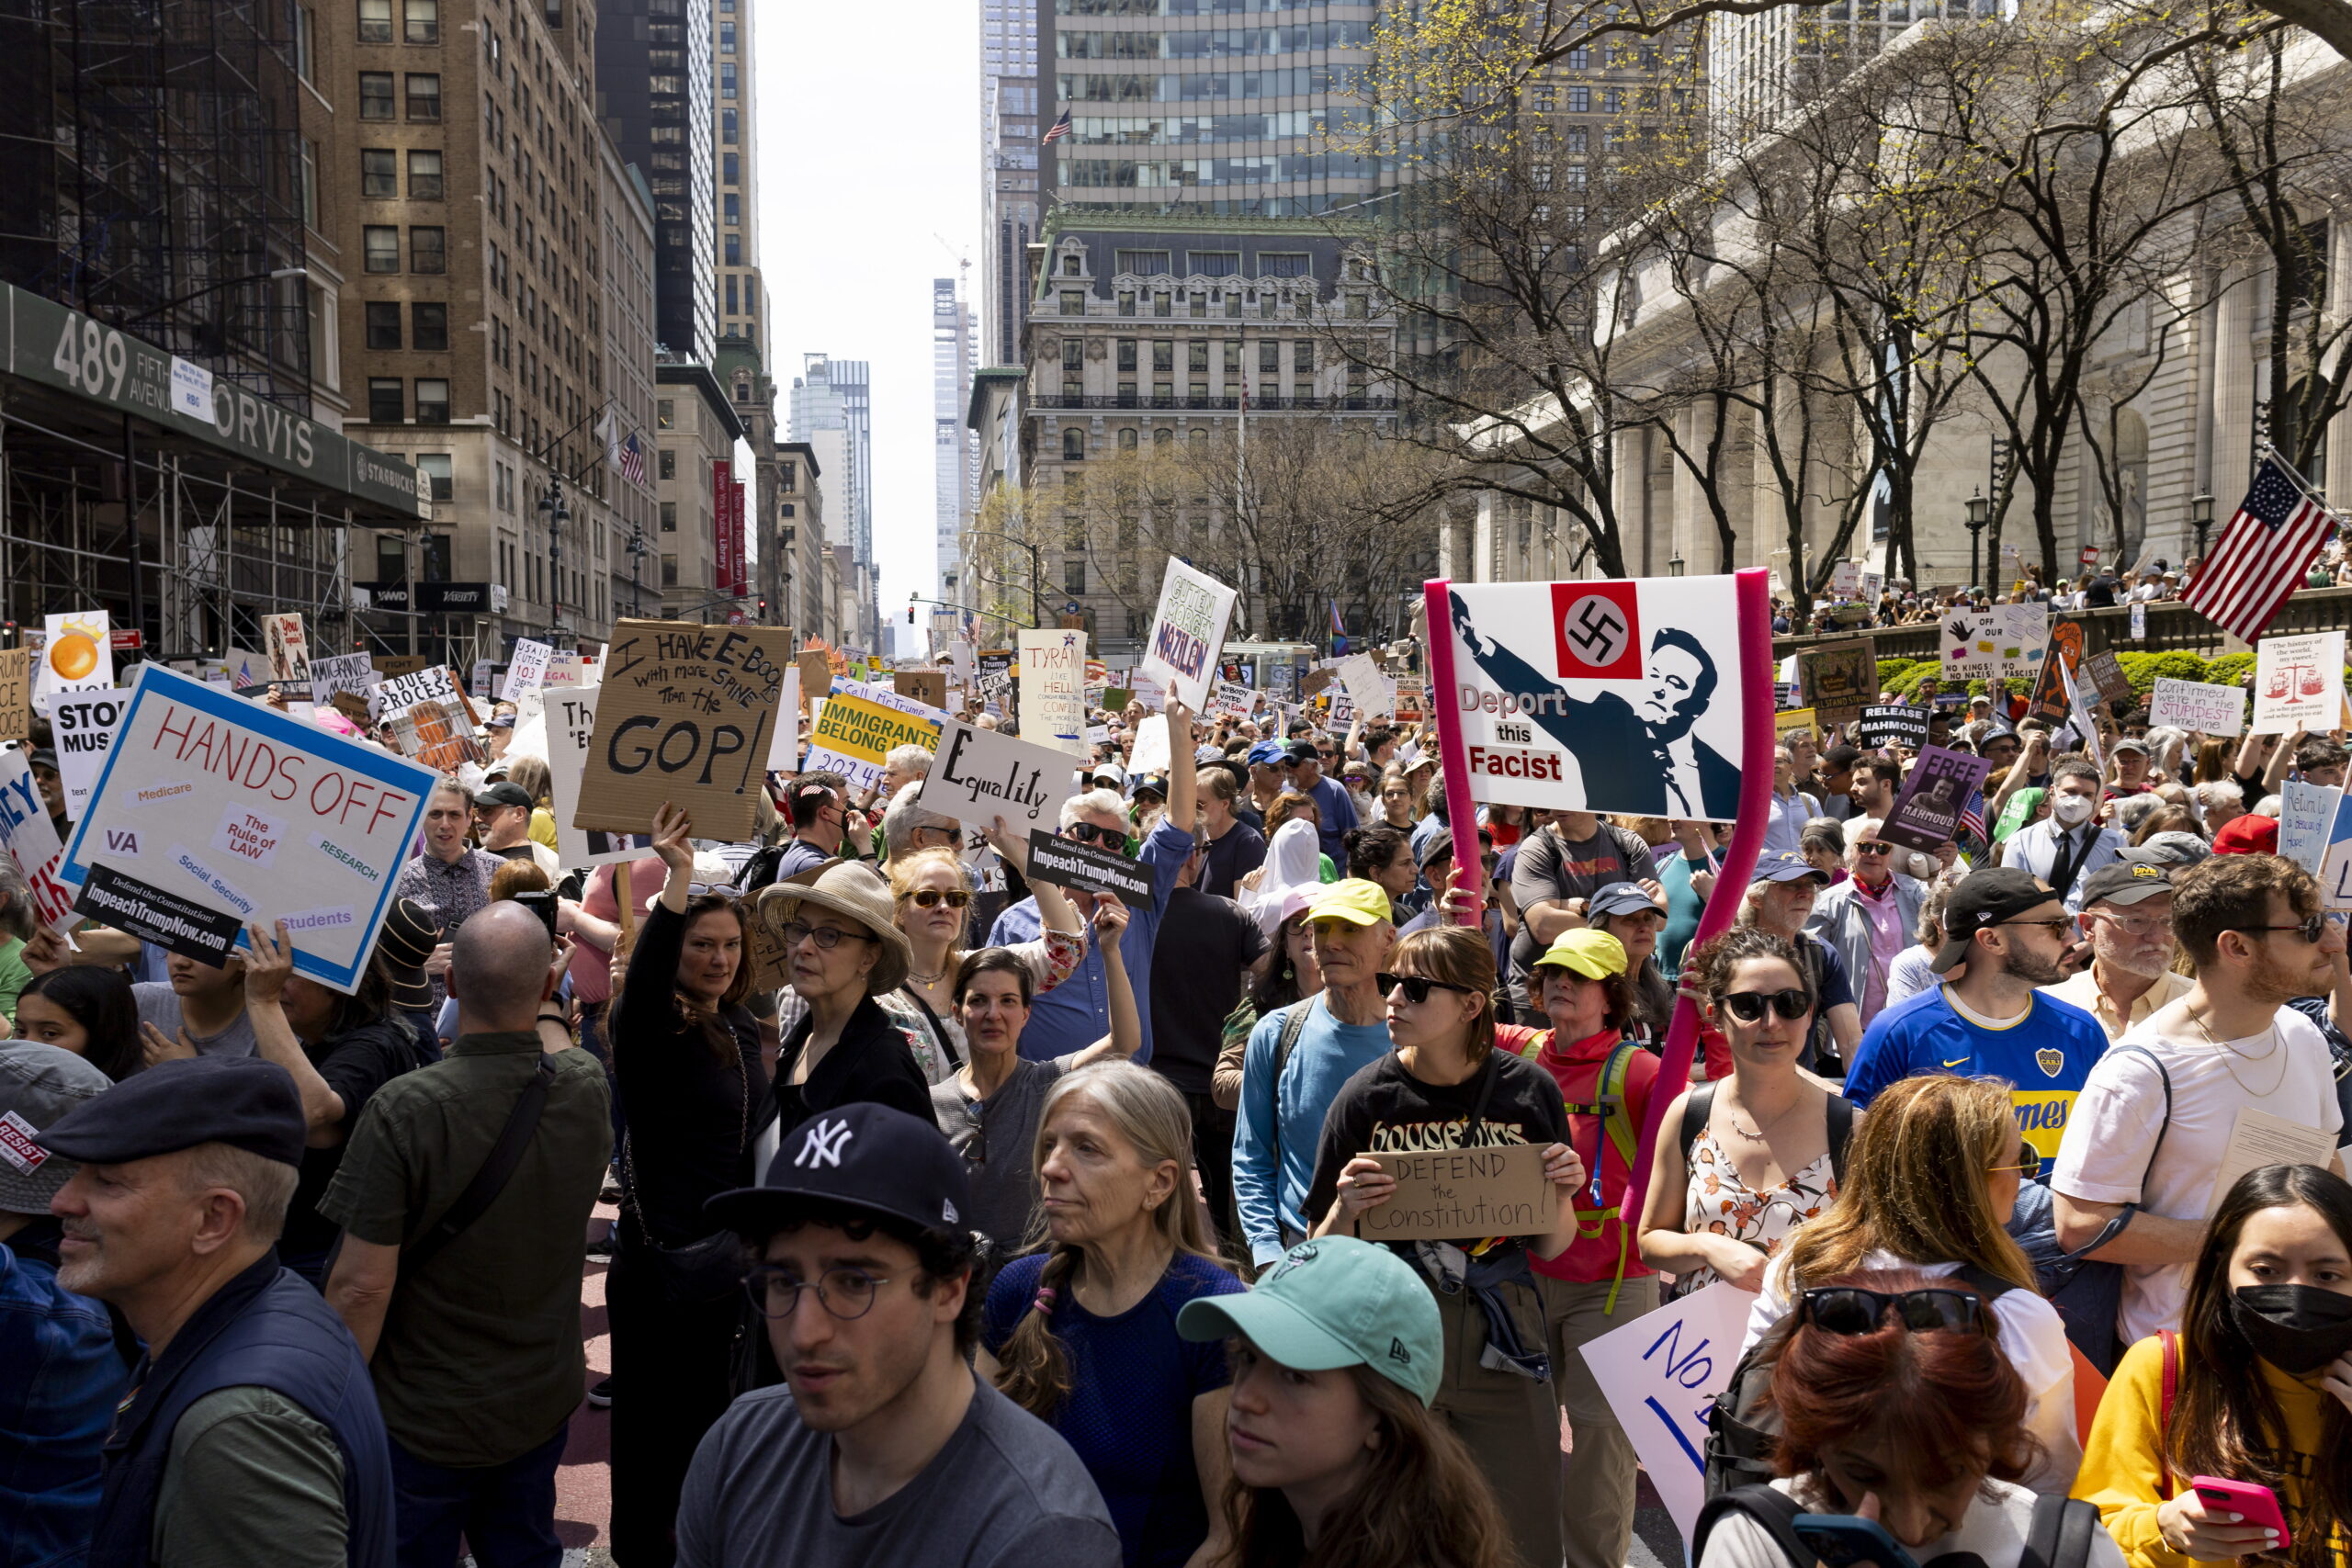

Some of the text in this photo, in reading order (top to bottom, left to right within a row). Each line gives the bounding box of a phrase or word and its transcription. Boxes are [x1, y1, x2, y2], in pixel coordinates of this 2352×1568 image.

[53, 311, 128, 402] 489
[137, 351, 171, 382] FIFTH
[129, 377, 178, 416] AVENU
[211, 384, 314, 468] ORVIS
[368, 462, 414, 494] STARBUCKS
[718, 538, 728, 570] Library
[443, 591, 479, 602] VARIETY
[1171, 575, 1216, 618] GUTEN
[279, 617, 299, 636] You
[1164, 598, 1215, 644] MORGEN
[1985, 628, 2002, 637] OUR
[517, 641, 548, 659] USAID
[0, 652, 26, 680] RUMP
[311, 655, 370, 682] MMIGRANTS
[516, 665, 535, 679] 103
[545, 671, 574, 681] EGAL
[612, 631, 782, 705] I HAVE E-BOOKS
[982, 660, 1007, 669] Trump
[1950, 670, 1994, 680] NO NAZIS!
[1962, 662, 1993, 671] KINGS!
[379, 677, 456, 709] PROCESS
[394, 671, 425, 692] DUE
[674, 664, 709, 678] more
[710, 668, 759, 712] SPINE
[981, 672, 1004, 689] FUCK
[1044, 682, 1072, 694] HELL
[1219, 684, 1249, 698] NOBODY
[2157, 680, 2227, 698] Confirmed
[0, 682, 18, 708] CE
[692, 687, 721, 716] the
[893, 698, 925, 716] Trump
[1215, 699, 1248, 714] FOR ELON
[1219, 694, 1241, 704] VOTED
[1458, 682, 1569, 718] Deport
[2215, 700, 2234, 709] the
[0, 709, 24, 735] OGE
[58, 701, 126, 731] STO
[1866, 707, 1923, 719] RELEASE
[2160, 703, 2233, 721] STUPIDEST
[818, 719, 887, 753] BELONG
[822, 702, 941, 751] IMMIGRANTS
[1497, 724, 1532, 743] this
[1777, 721, 1811, 732] Mahmoud
[1860, 720, 1927, 734] MAHMOUD
[63, 731, 113, 753] MUS
[608, 710, 767, 795] GOP!
[153, 705, 407, 835] HANDS OFF
[942, 728, 1048, 820] Equality
[1469, 746, 1563, 782] Facist
[1926, 753, 1980, 781] FREE
[72, 787, 87, 796] text
[137, 782, 192, 802] Medicare
[245, 814, 269, 833] The
[107, 829, 139, 853] VA
[228, 823, 277, 851] Rule of
[230, 839, 264, 860] LAW
[320, 840, 379, 882] RESEARCH
[1050, 839, 1136, 871] Defend the Constitution!
[1033, 845, 1148, 896] ImpeachTrumpNow.com
[178, 854, 254, 915] Social Security
[111, 876, 216, 924] Defend the Constitution!
[86, 882, 227, 952] ImpeachTrumpNow.com
[280, 911, 353, 931] Students
[2015, 1099, 2068, 1131] mes
[0, 1124, 45, 1160] RESIST
[1396, 1152, 1506, 1181] DEFEND
[1430, 1182, 1457, 1200] the
